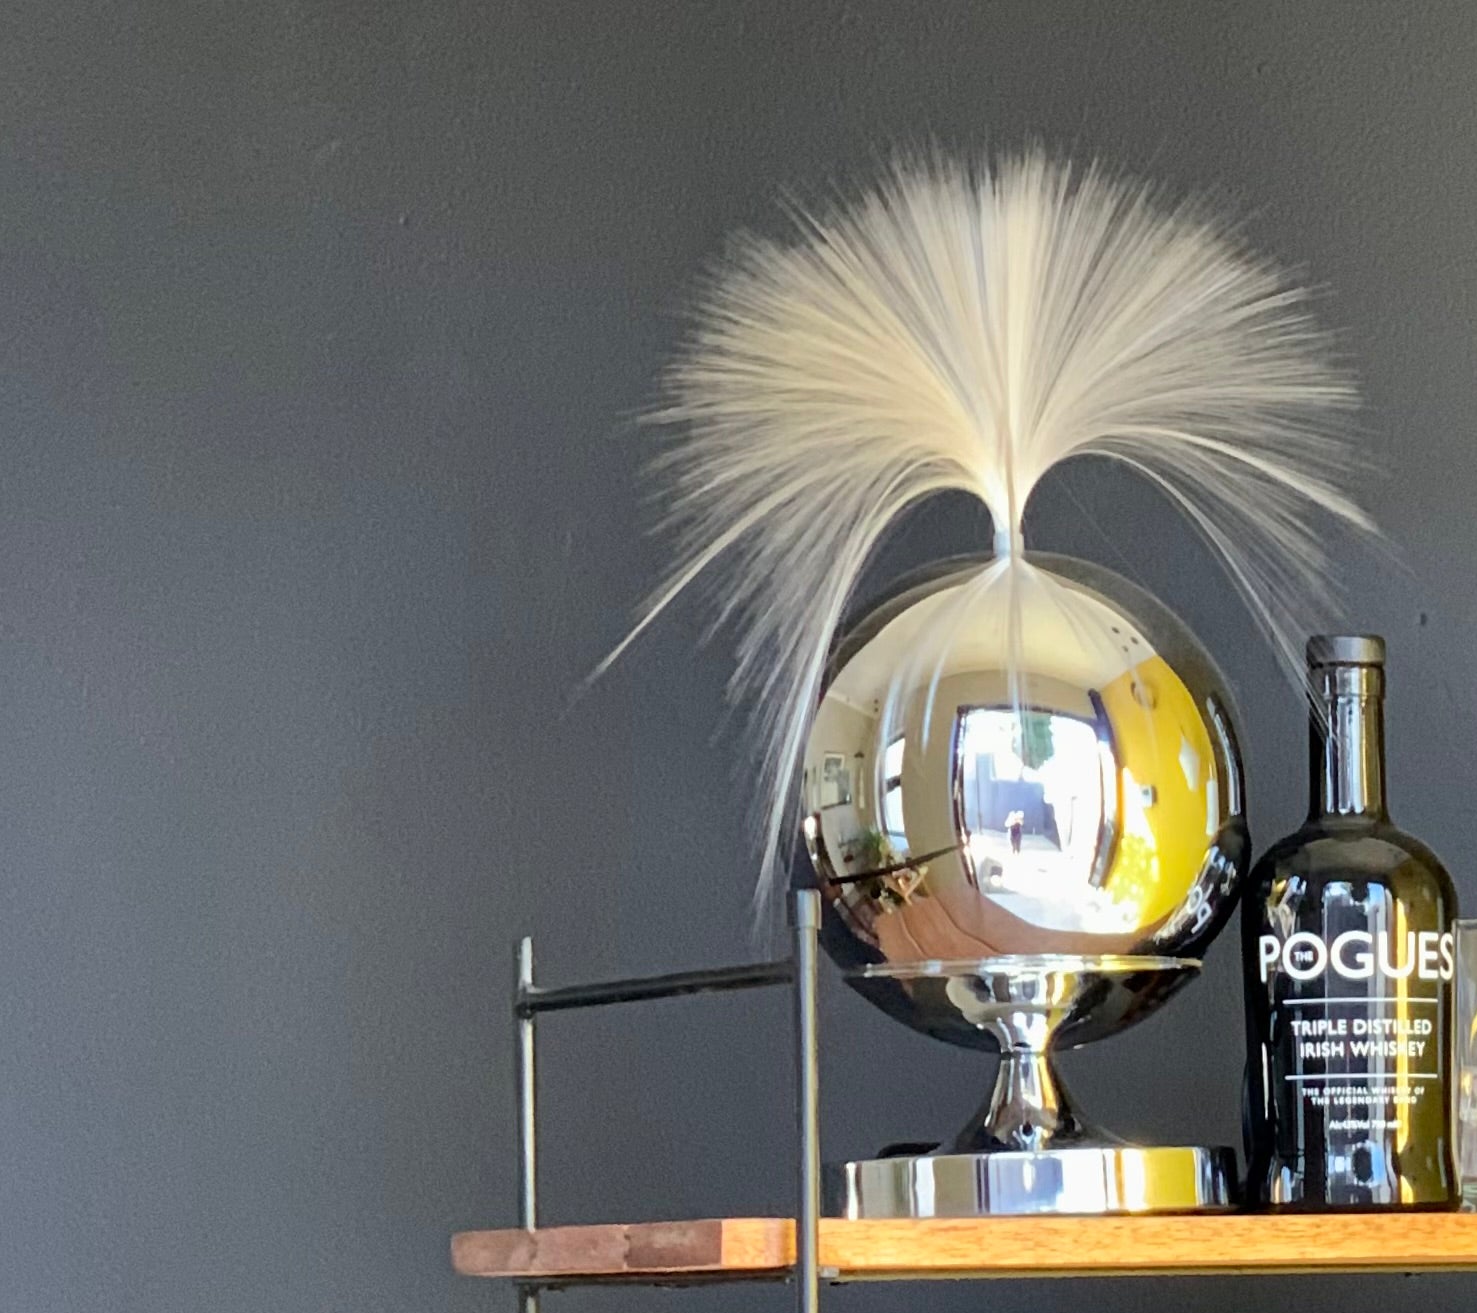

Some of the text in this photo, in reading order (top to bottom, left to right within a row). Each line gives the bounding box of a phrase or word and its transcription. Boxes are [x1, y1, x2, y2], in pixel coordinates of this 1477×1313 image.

[1259, 930, 1454, 984] POGUES
[1294, 951, 1314, 962] THE
[1290, 1019, 1432, 1036] TRIPLE DISTILLED
[1300, 1041, 1345, 1058] IRISH
[1302, 1087, 1319, 1096] THE
[1323, 1087, 1368, 1095] OFFICIAL
[1372, 1086, 1411, 1095] WHISY
